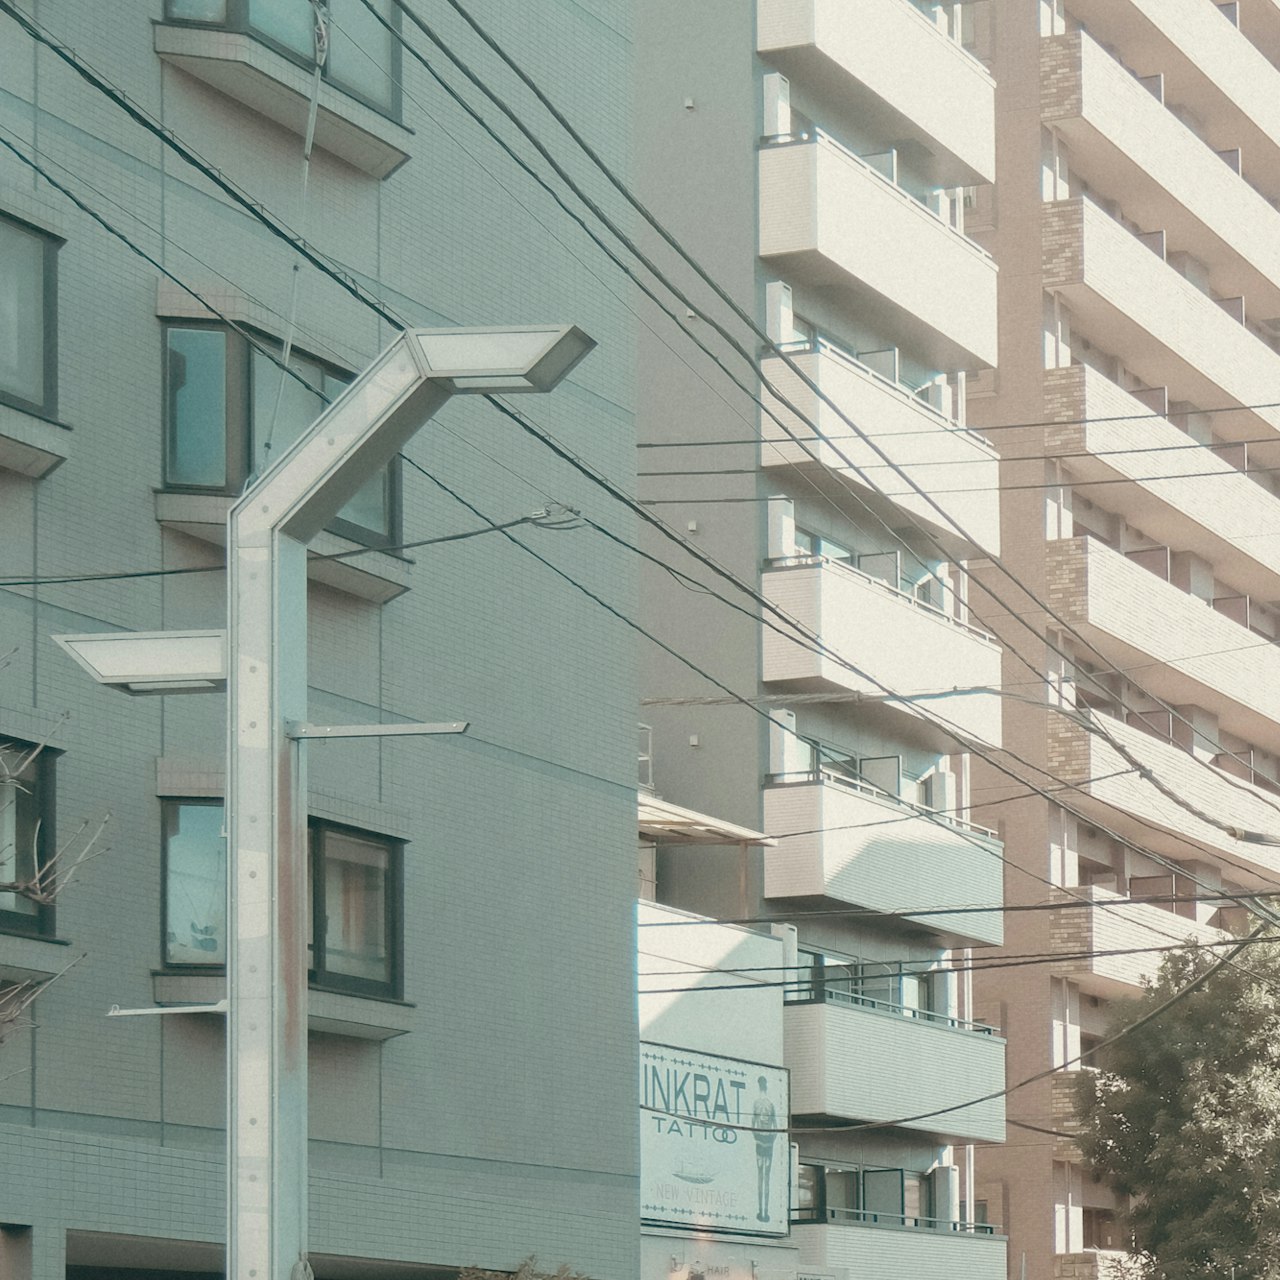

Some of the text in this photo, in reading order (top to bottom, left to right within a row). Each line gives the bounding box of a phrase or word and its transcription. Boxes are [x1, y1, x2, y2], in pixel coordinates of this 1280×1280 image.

[644, 1063, 746, 1125] INKRAT
[651, 1116, 738, 1145] TATTOO
[655, 1182, 738, 1208] NEW VINTAGE
[707, 1266, 730, 1277] HAIR
